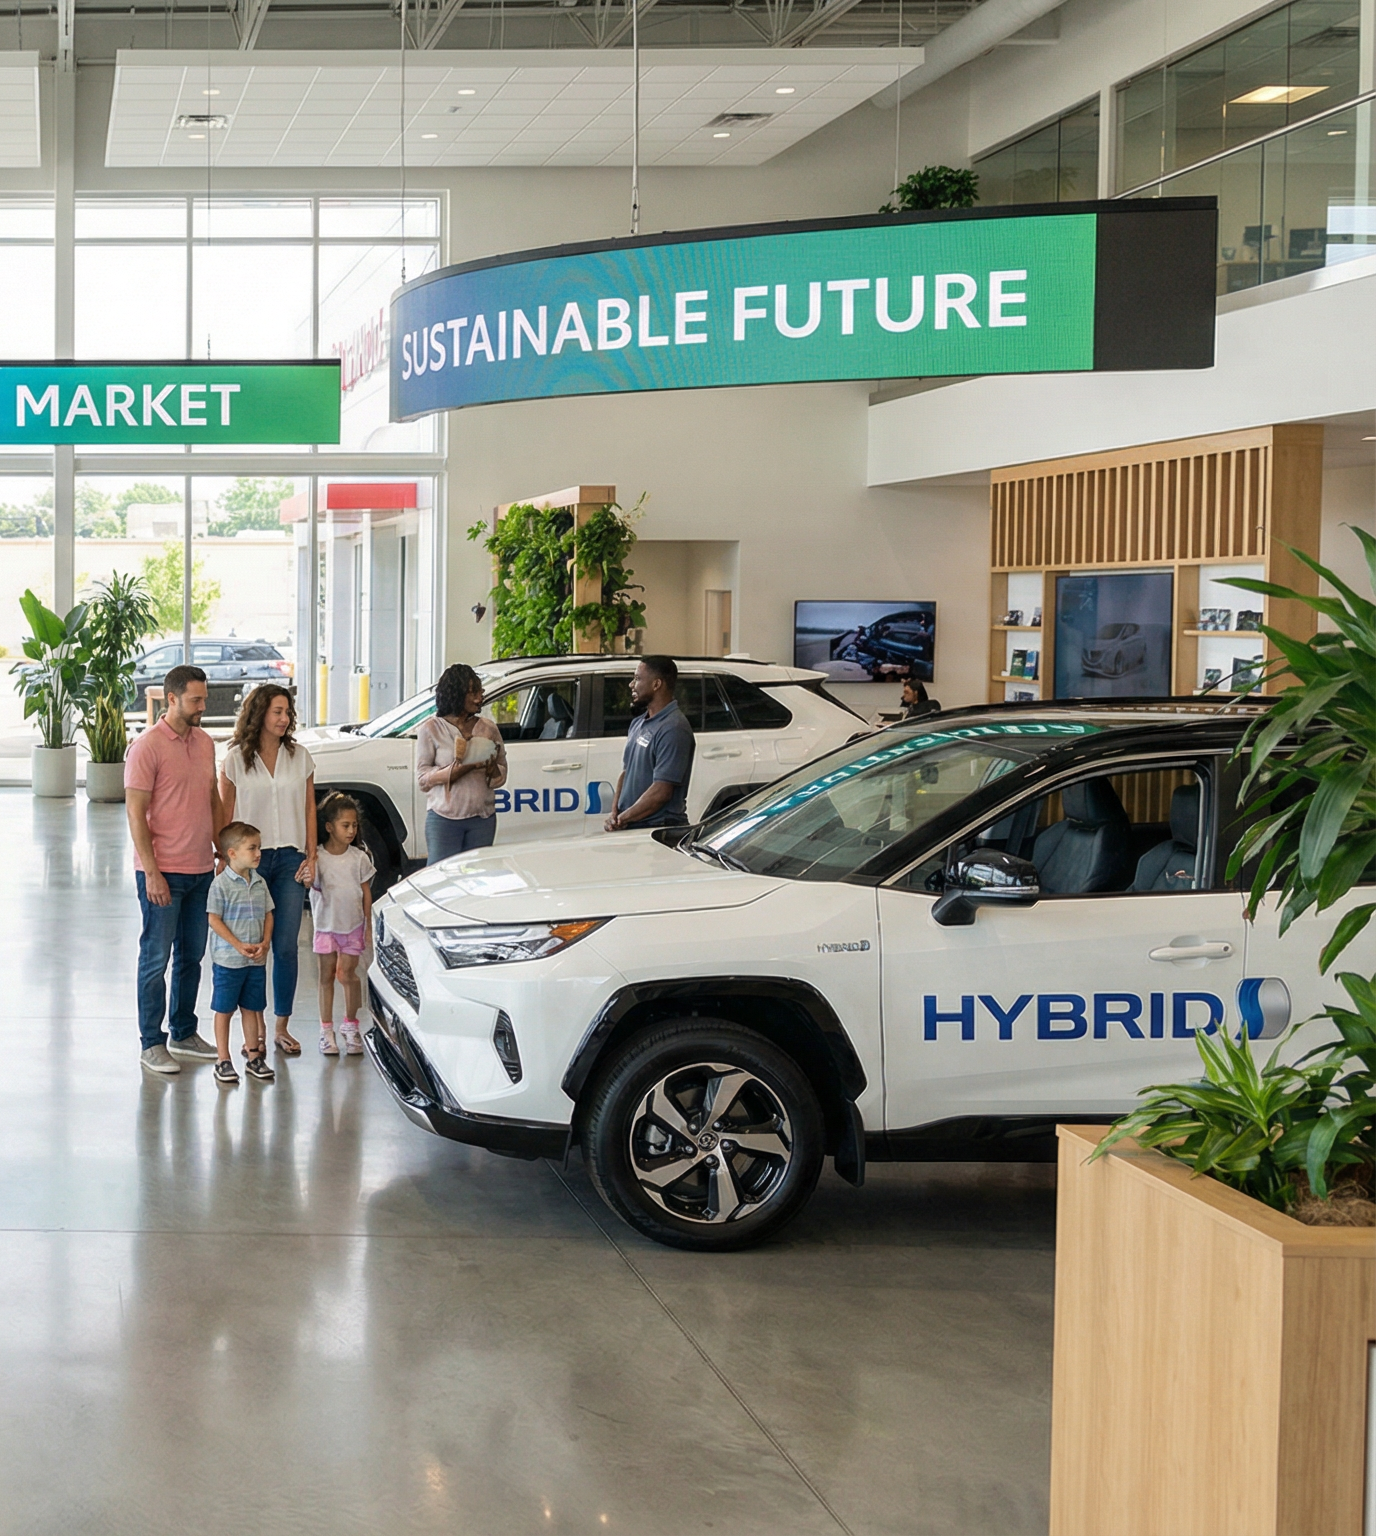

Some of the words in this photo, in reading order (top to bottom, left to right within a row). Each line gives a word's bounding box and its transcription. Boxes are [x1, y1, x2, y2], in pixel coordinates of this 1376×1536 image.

[402, 290, 708, 380] SUSTAINABLE
[734, 269, 1027, 341] FUTURE
[17, 384, 240, 427] MARKET
[494, 788, 579, 812] BRID
[923, 992, 1225, 1041] HYBRID
